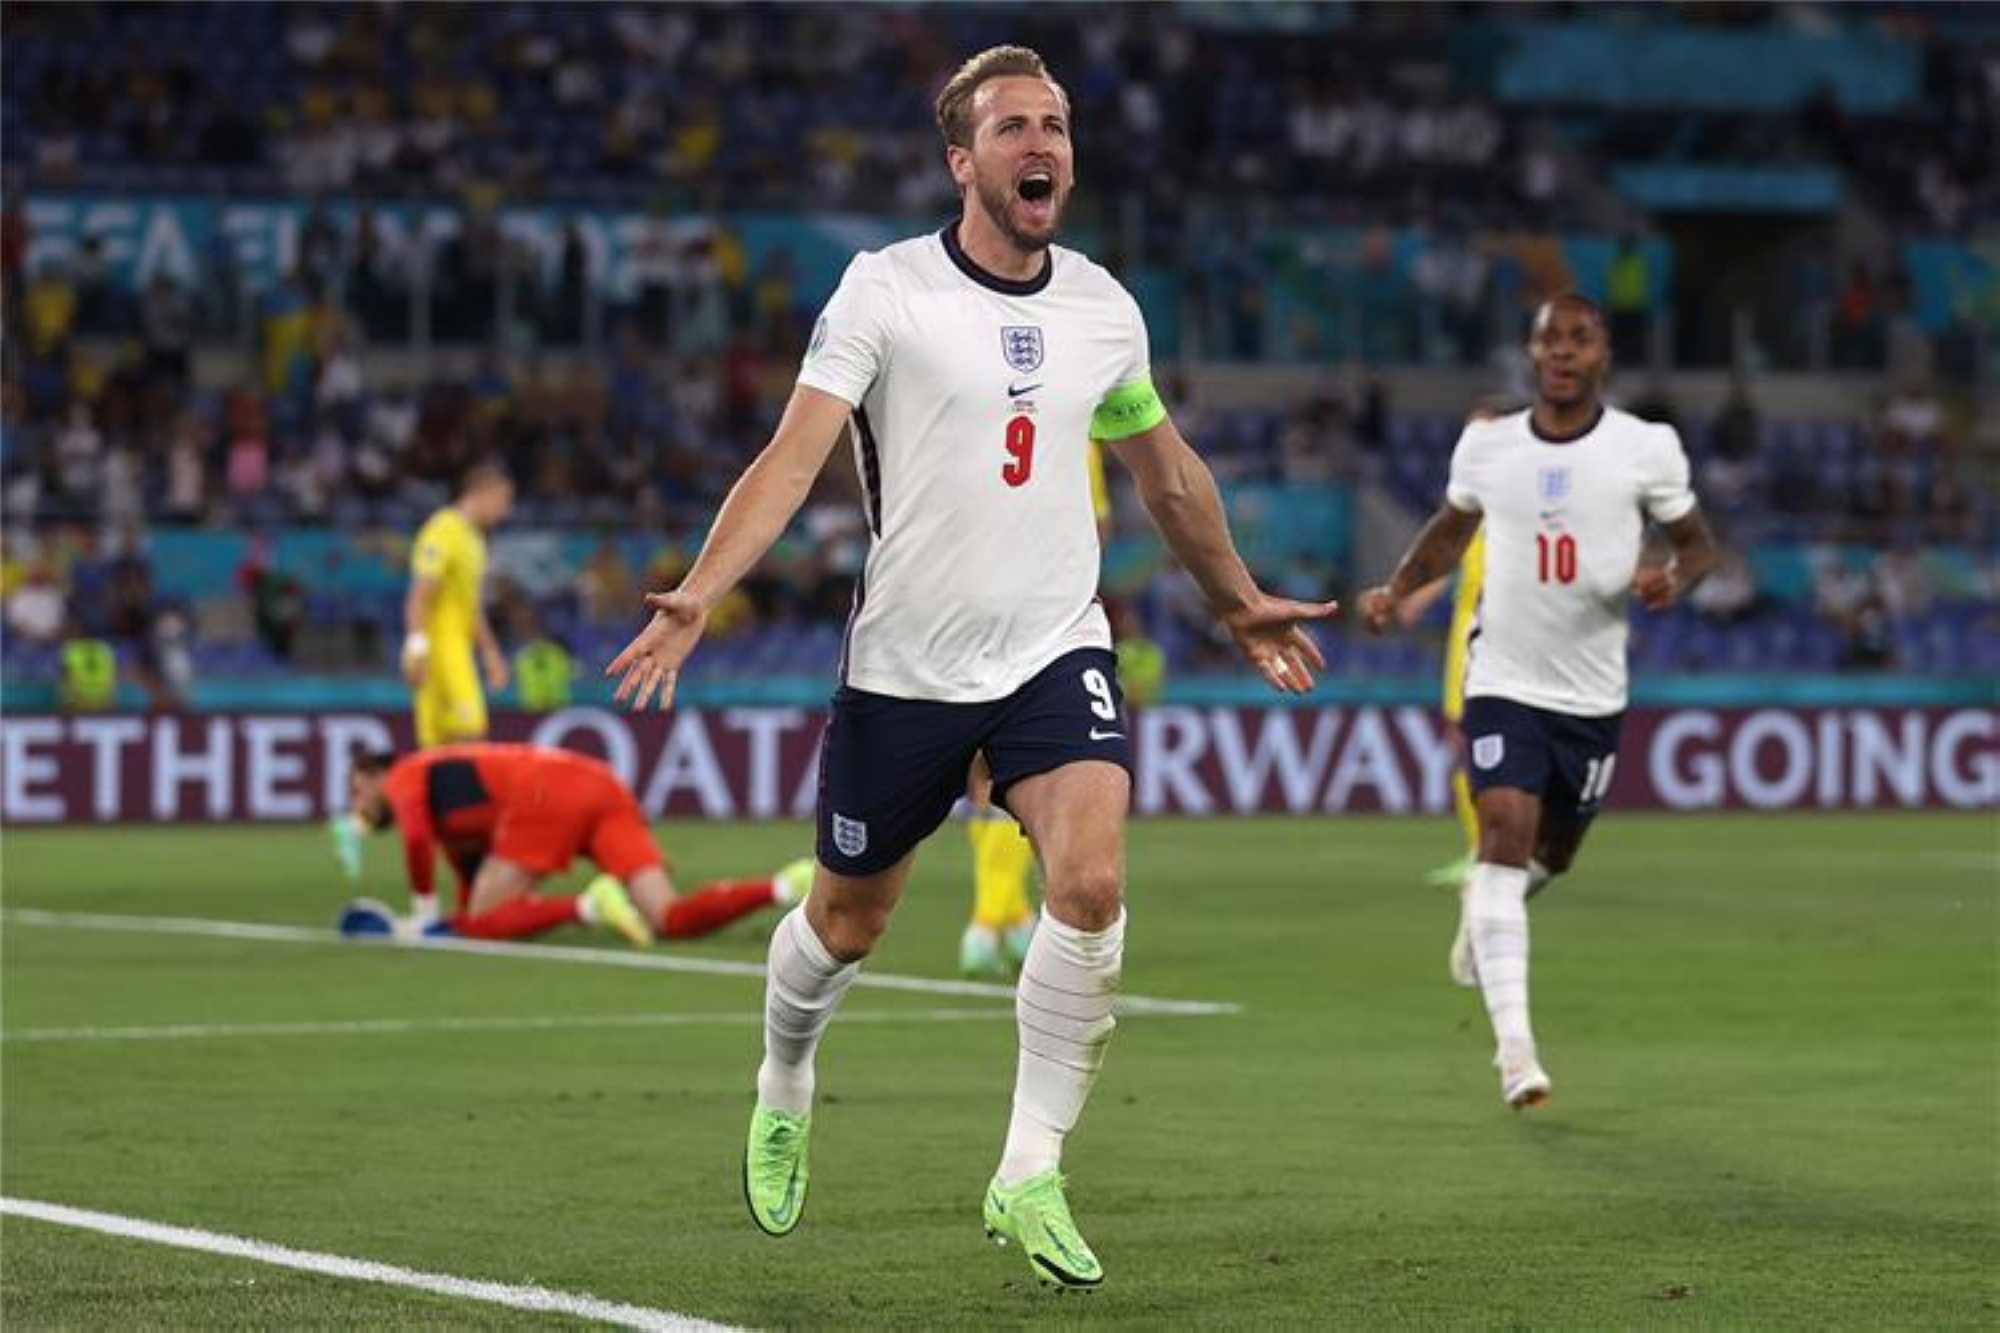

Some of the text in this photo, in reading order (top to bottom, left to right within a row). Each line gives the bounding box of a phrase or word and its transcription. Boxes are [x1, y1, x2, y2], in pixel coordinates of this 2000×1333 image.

[1002, 415, 1037, 488] 9
[1535, 533, 1578, 585] 10
[1082, 668, 1117, 721] 9
[1649, 709, 2000, 809] GOING
